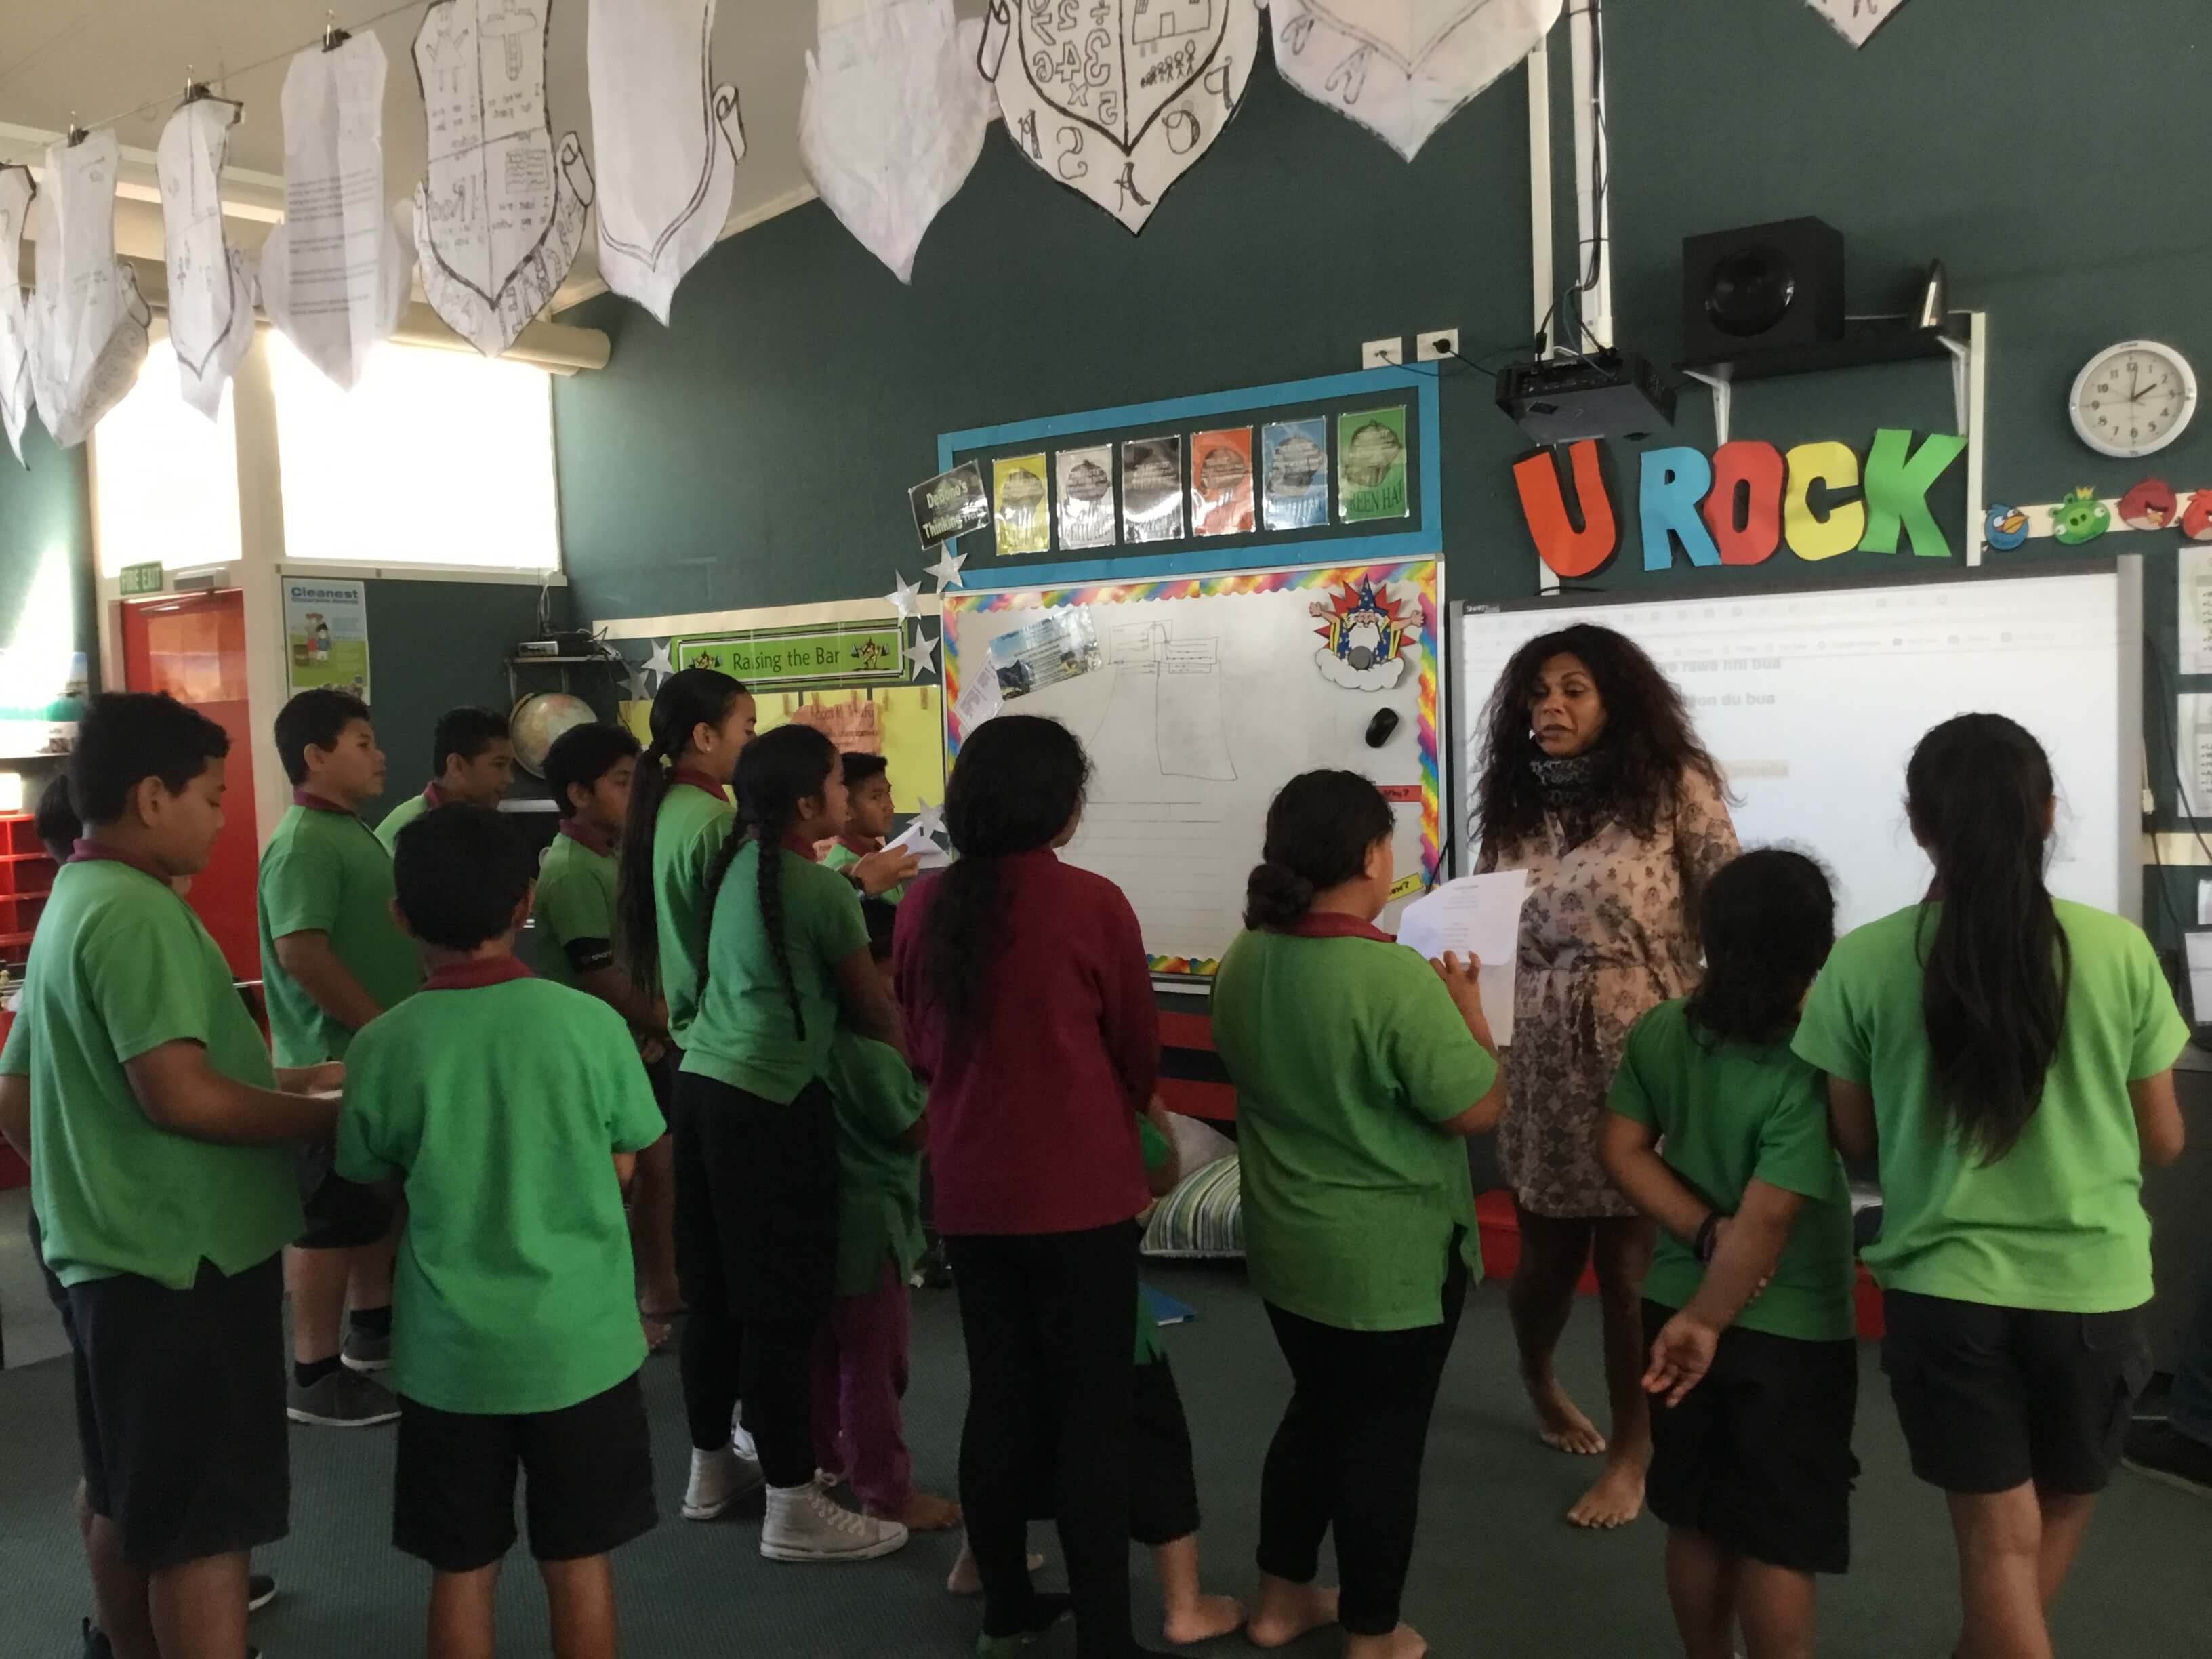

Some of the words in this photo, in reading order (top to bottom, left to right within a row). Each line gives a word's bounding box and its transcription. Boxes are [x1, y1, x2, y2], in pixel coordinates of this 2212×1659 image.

[2110, 370, 2119, 379] 11
[2148, 365, 2153, 374] 1
[2161, 374, 2168, 384] 2
[2097, 383, 2109, 394] 10
[2091, 400, 2100, 411] 9
[2160, 407, 2169, 417] 4
[2098, 415, 2108, 427] 8
[2148, 420, 2156, 432] 5
[2112, 426, 2120, 436] 7
[2130, 428, 2138, 438] 6
[926, 480, 968, 510] DeBono's
[1513, 438, 1617, 577] U
[1639, 428, 1968, 572] ROCK
[922, 514, 963, 539] Thinking
[291, 587, 358, 599] Cleanest
[788, 649, 810, 666] the
[815, 647, 840, 665] Bar
